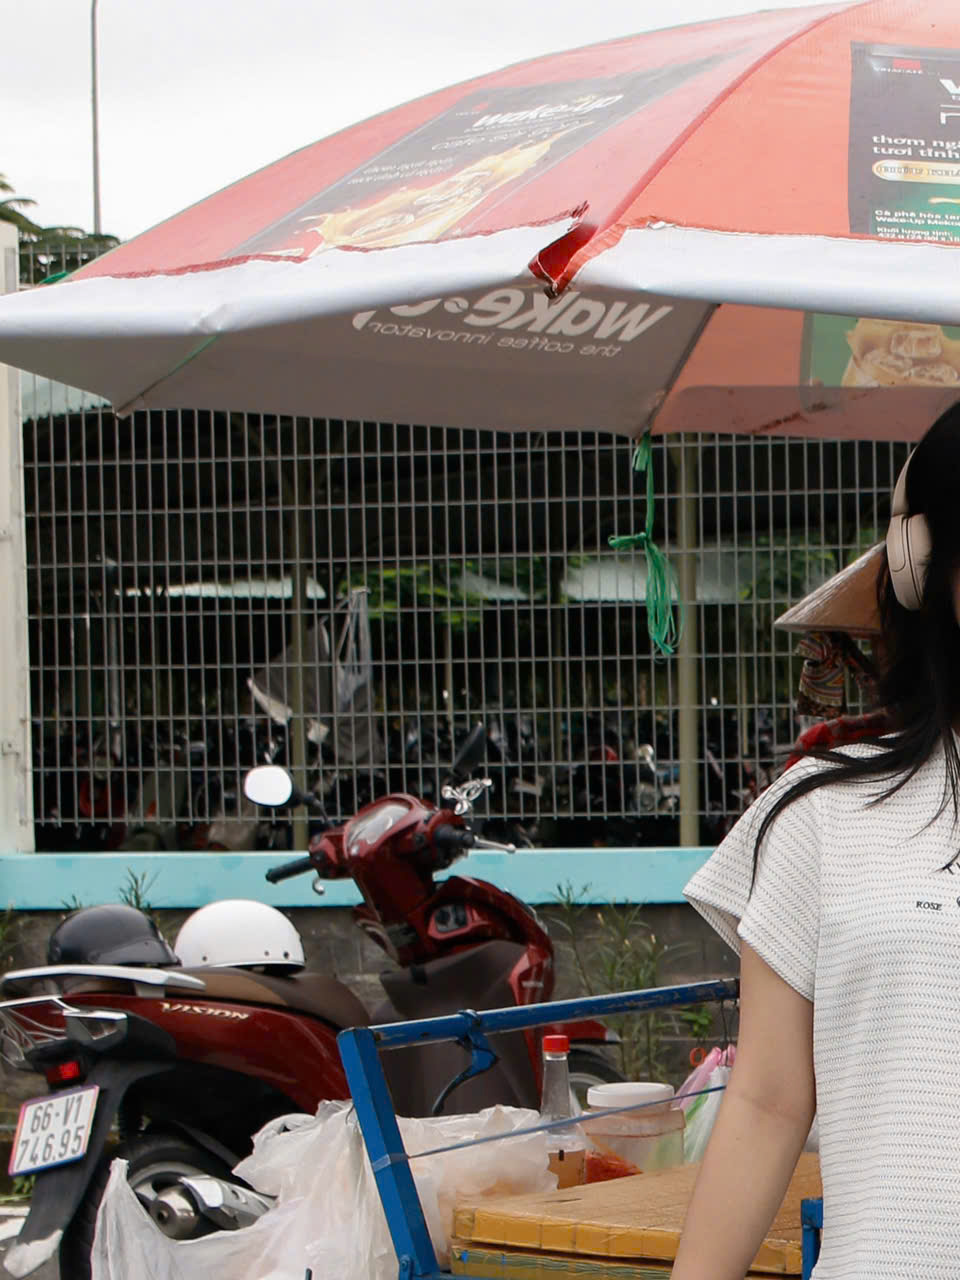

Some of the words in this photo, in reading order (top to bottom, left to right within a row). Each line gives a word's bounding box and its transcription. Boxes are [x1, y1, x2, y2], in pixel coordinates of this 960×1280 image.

[915, 900, 943, 911] ROSE
[160, 1002, 250, 1021] VISION
[30, 1094, 84, 1134] 66-V1
[19, 1125, 86, 1171] 746.95
